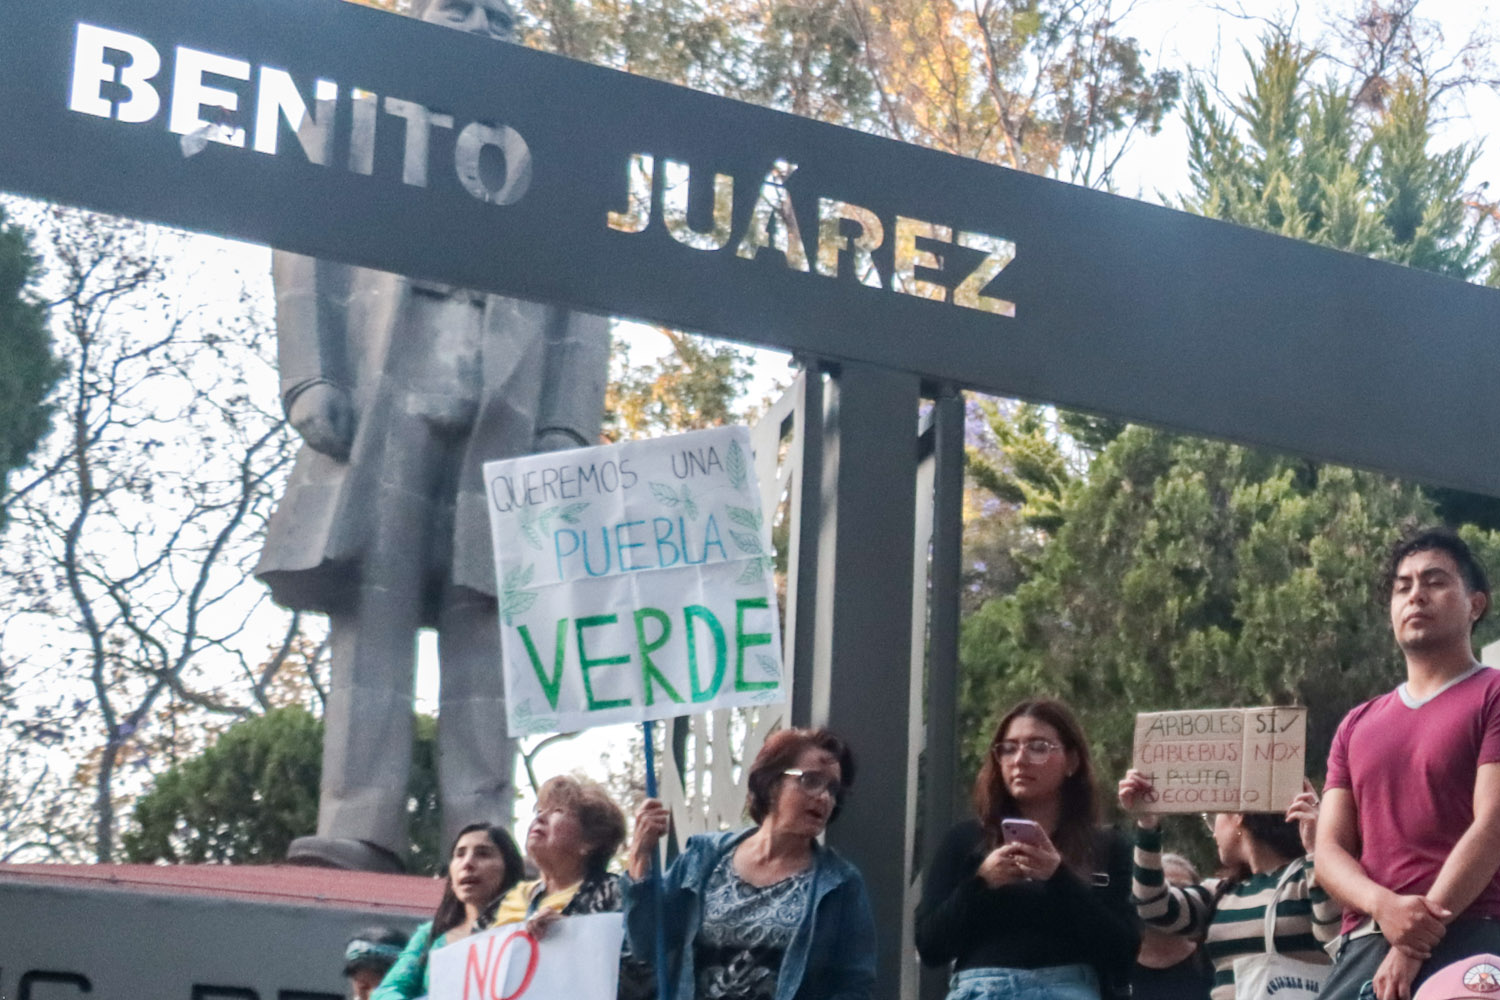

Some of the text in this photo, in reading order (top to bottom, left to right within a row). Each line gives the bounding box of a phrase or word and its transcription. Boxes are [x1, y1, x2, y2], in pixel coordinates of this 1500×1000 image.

[67, 21, 1017, 319] BENITO JUÁREZ
[490, 445, 725, 512] QUEREMOS UNA
[553, 513, 728, 581] PUEBLA
[516, 597, 780, 712] VERDE
[1140, 742, 1239, 764] CABLEBUS
[1144, 713, 1243, 738] ÁRBOLES
[1166, 769, 1230, 786] RUTA
